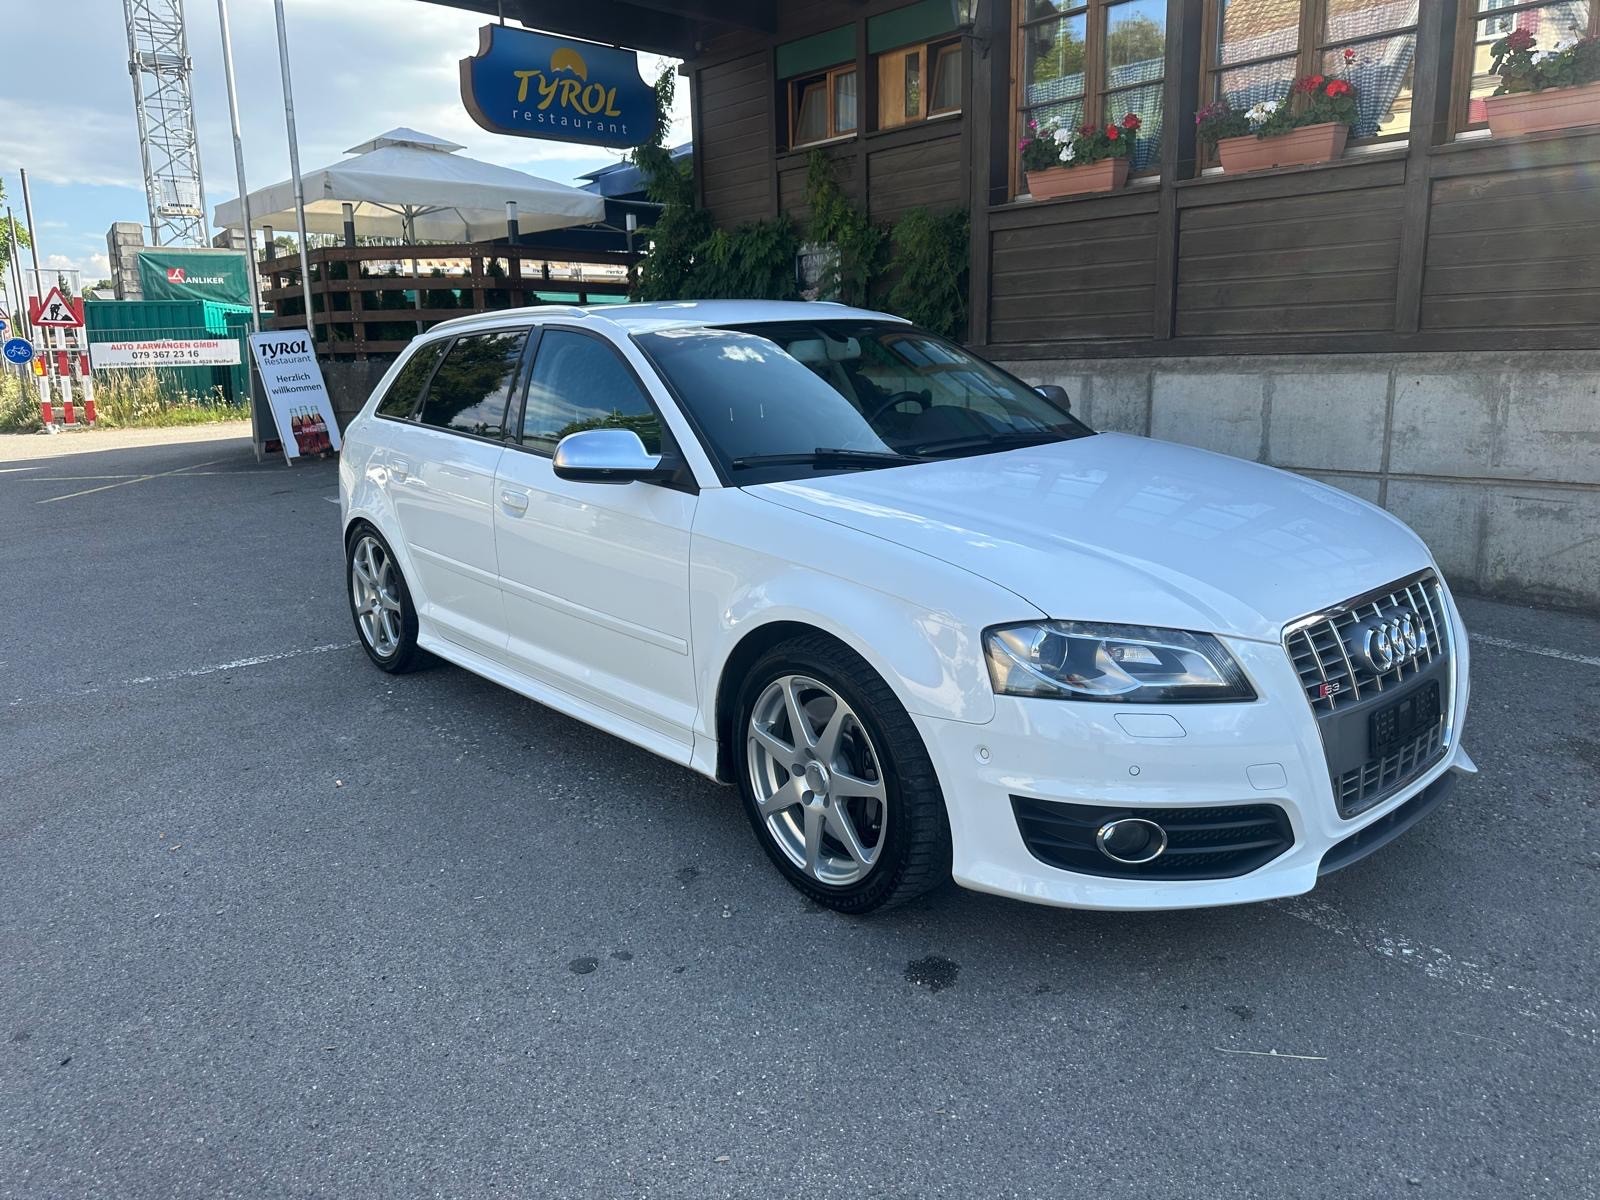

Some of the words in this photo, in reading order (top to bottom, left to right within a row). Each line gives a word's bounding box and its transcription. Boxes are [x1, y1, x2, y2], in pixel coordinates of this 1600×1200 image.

[514, 70, 621, 116] TYROL
[512, 109, 627, 134] restaurant
[185, 276, 225, 285] ANLIKER
[110, 342, 134, 351] AUTO
[136, 341, 191, 350] AARWANGEN
[193, 341, 219, 349] GMBH
[259, 340, 308, 359] TYROL
[131, 351, 150, 359] 079
[153, 351, 170, 359] 367
[173, 350, 185, 358] 23
[187, 350, 199, 358] 16
[264, 355, 312, 367] Restaurant
[276, 372, 311, 383] Herzlich
[271, 383, 322, 395] willkommen
[1324, 682, 1340, 695] S3
